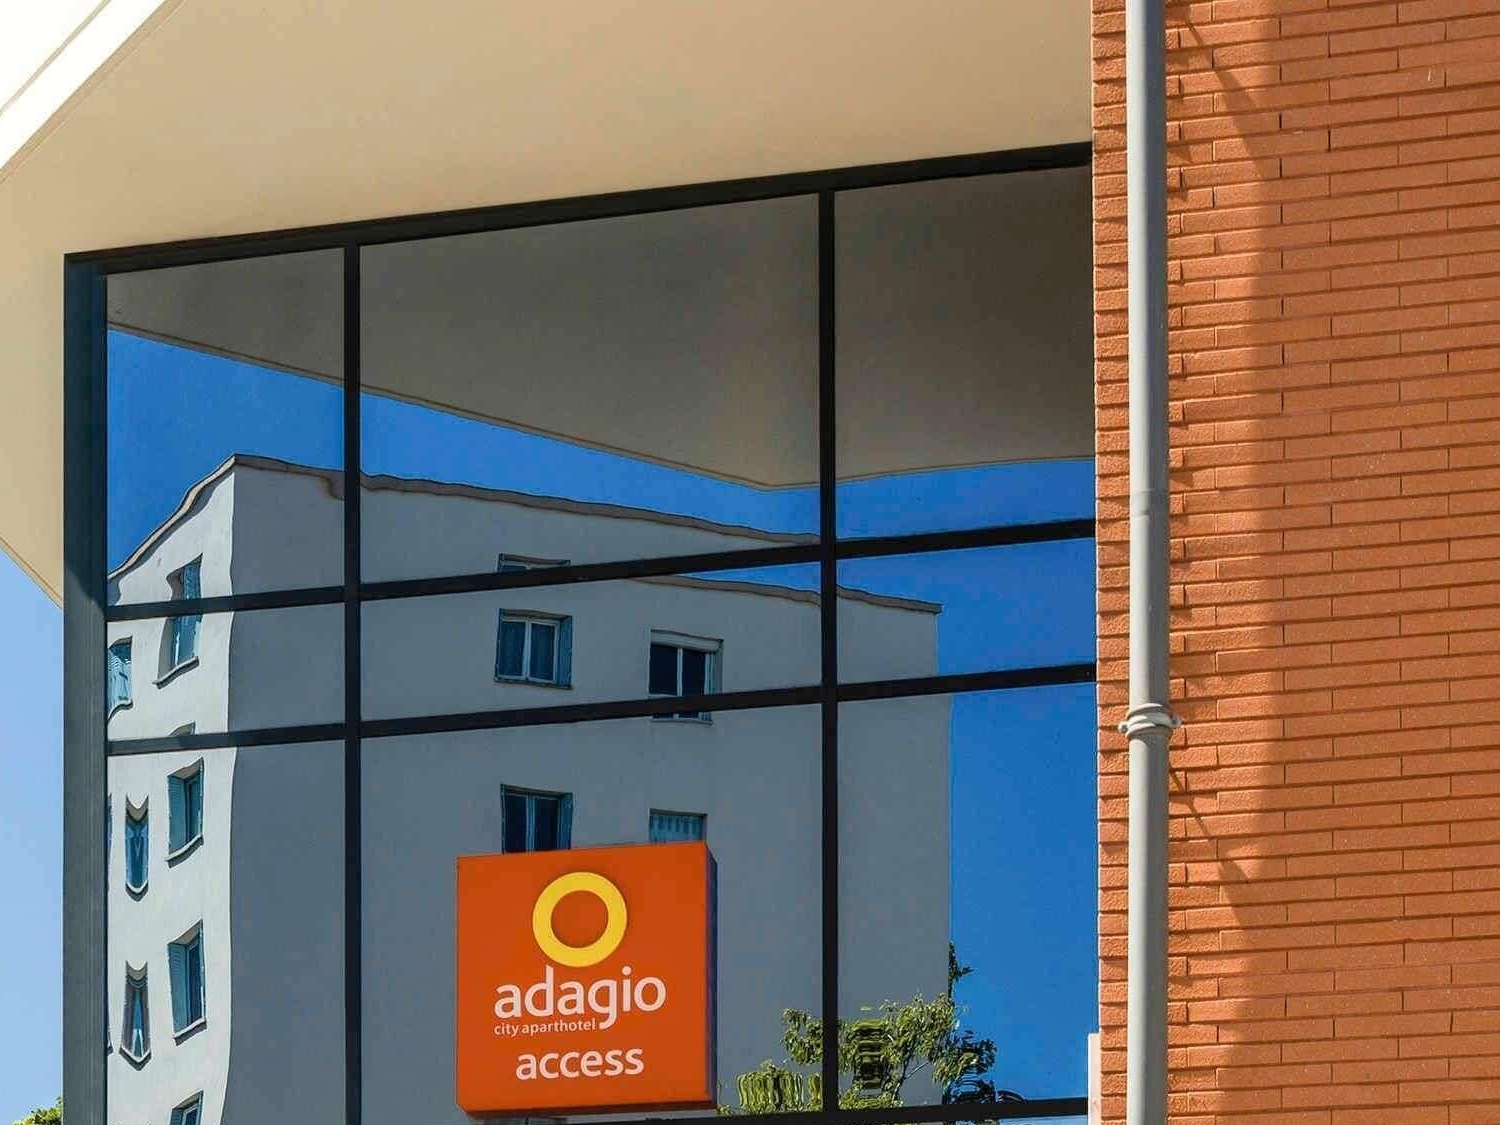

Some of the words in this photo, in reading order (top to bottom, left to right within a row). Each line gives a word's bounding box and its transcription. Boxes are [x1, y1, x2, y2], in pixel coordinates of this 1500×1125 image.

[493, 964, 667, 1030] adagio
[493, 1021, 520, 1038] city
[521, 1017, 597, 1037] aparthotel
[515, 1047, 645, 1081] access
